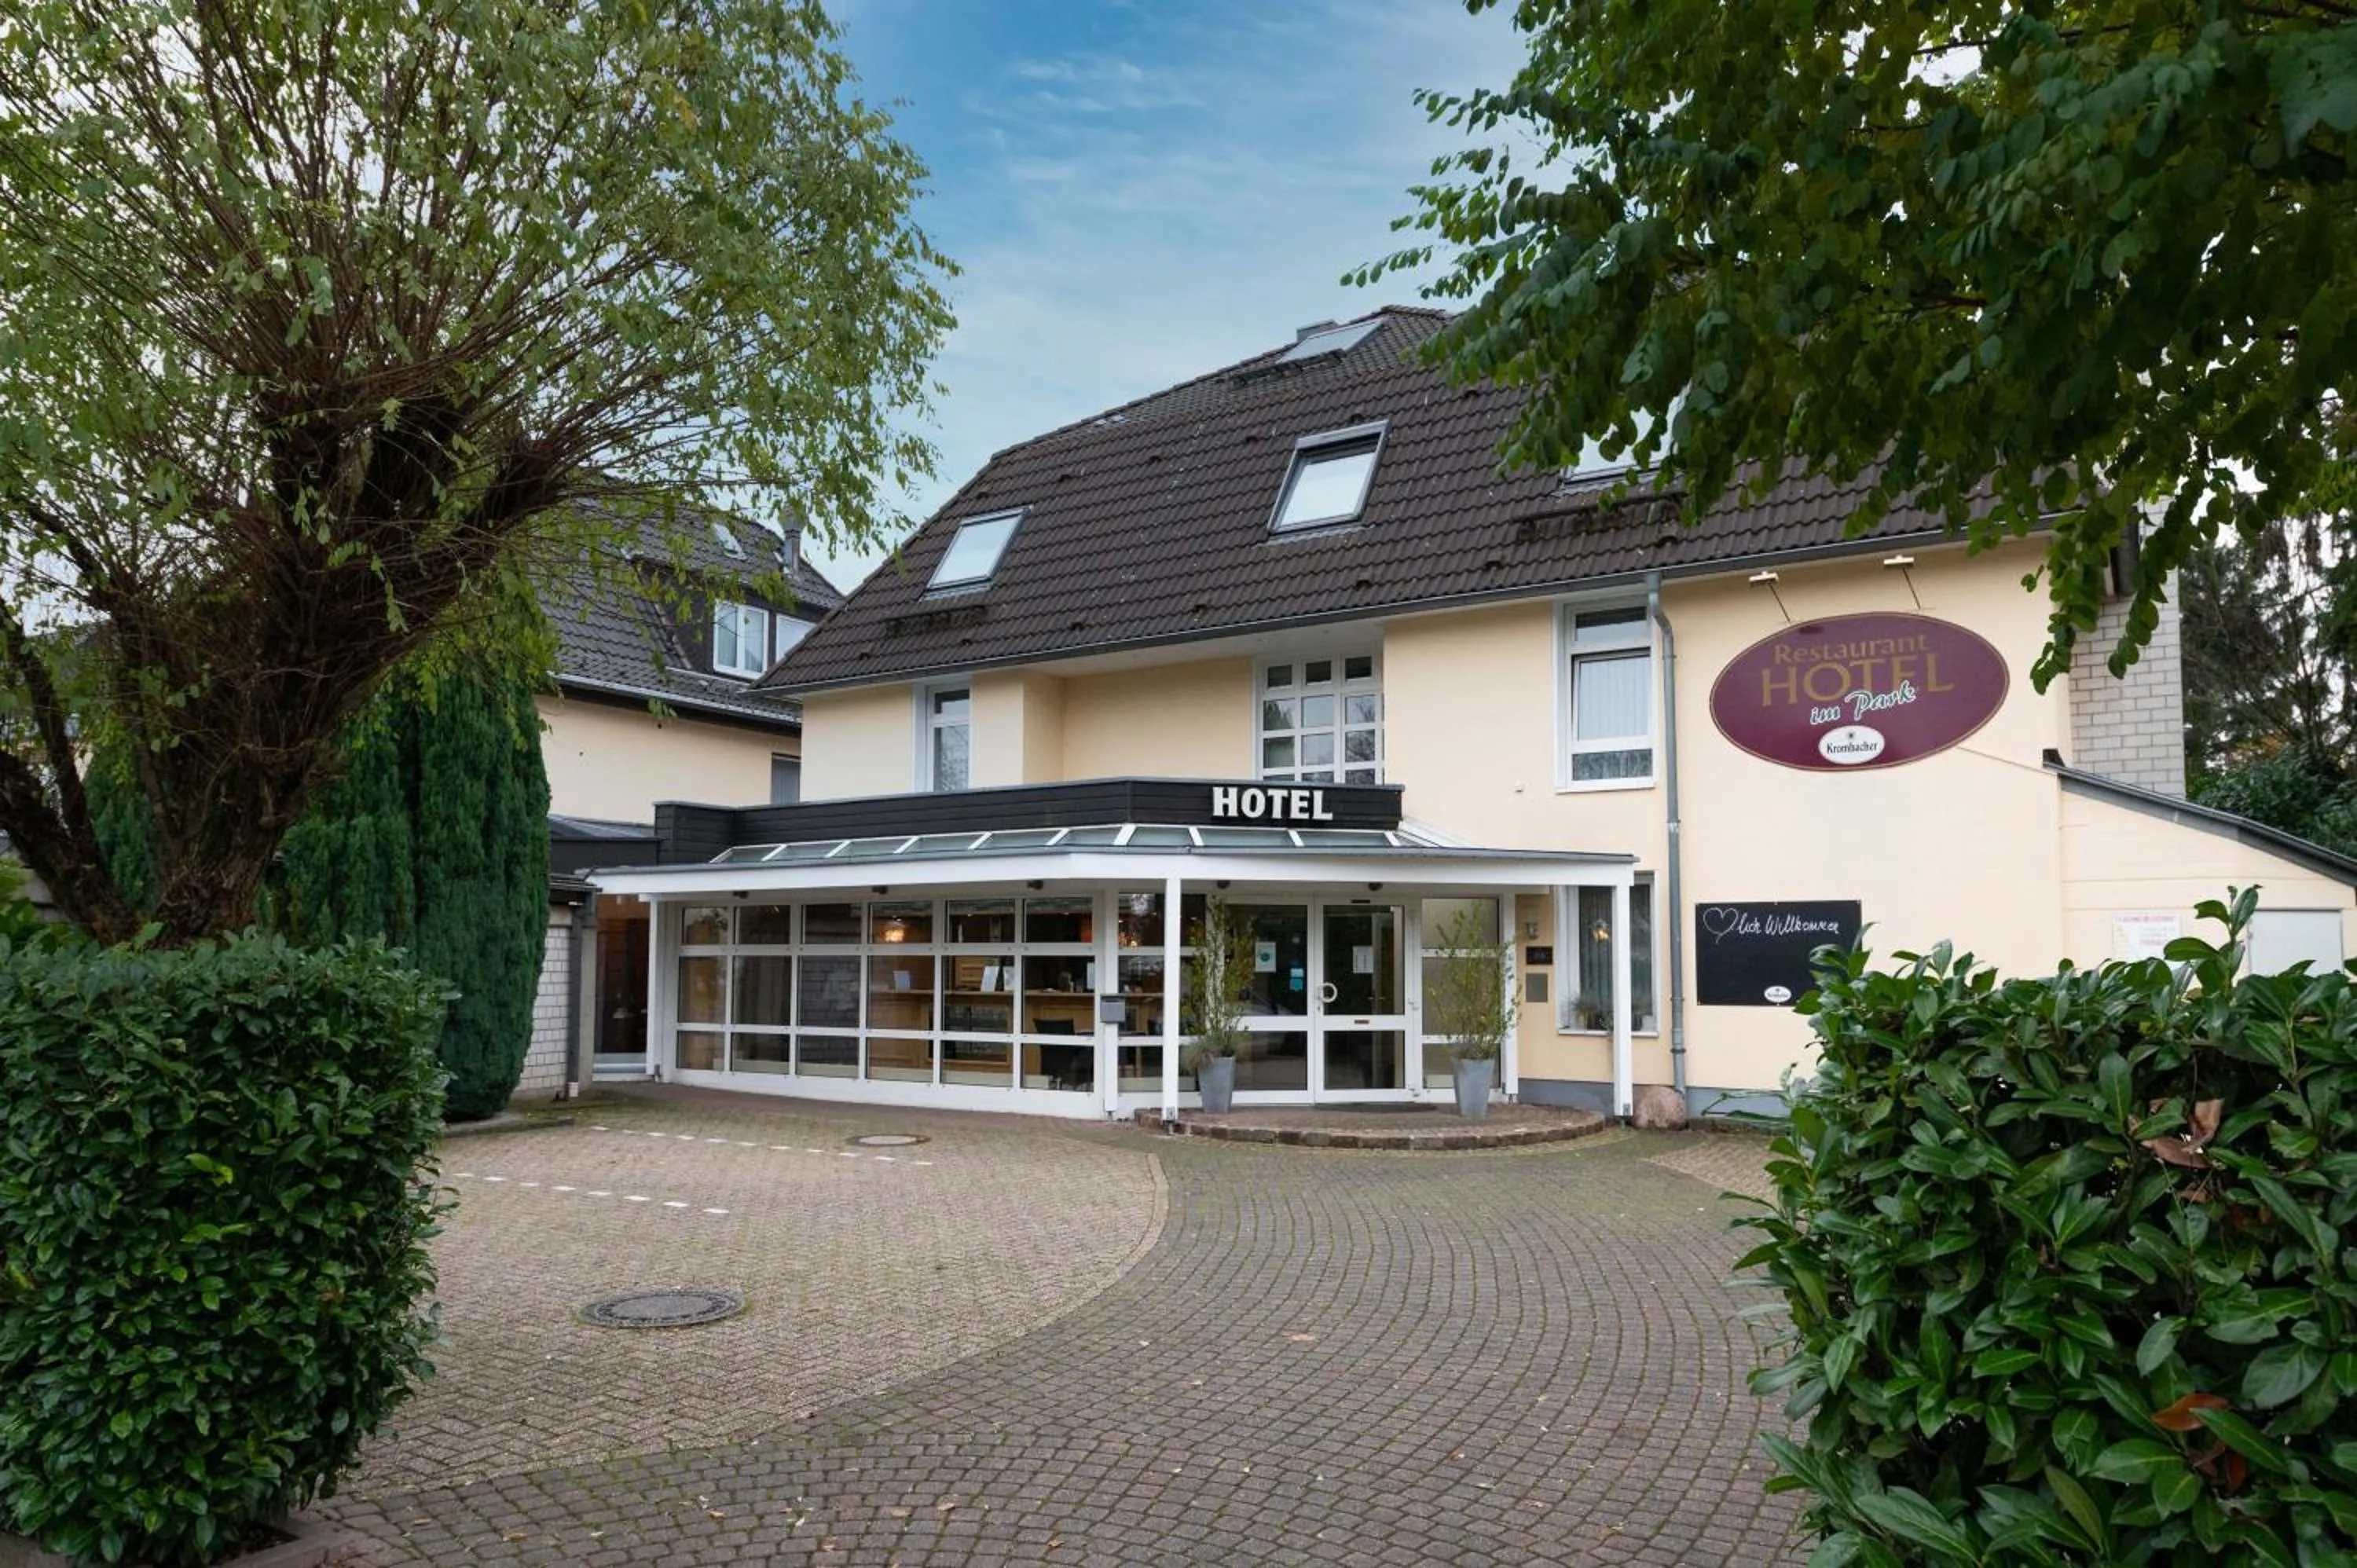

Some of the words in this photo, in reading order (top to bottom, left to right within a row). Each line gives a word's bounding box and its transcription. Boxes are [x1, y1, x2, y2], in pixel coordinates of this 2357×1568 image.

[1774, 635, 1927, 665] Restaurant
[1761, 653, 1955, 706] HOTEL
[1810, 706, 1841, 724] im
[1845, 680, 1916, 720] Park
[1827, 742, 1877, 753] Krombacher
[1212, 786, 1332, 820] HOTEL
